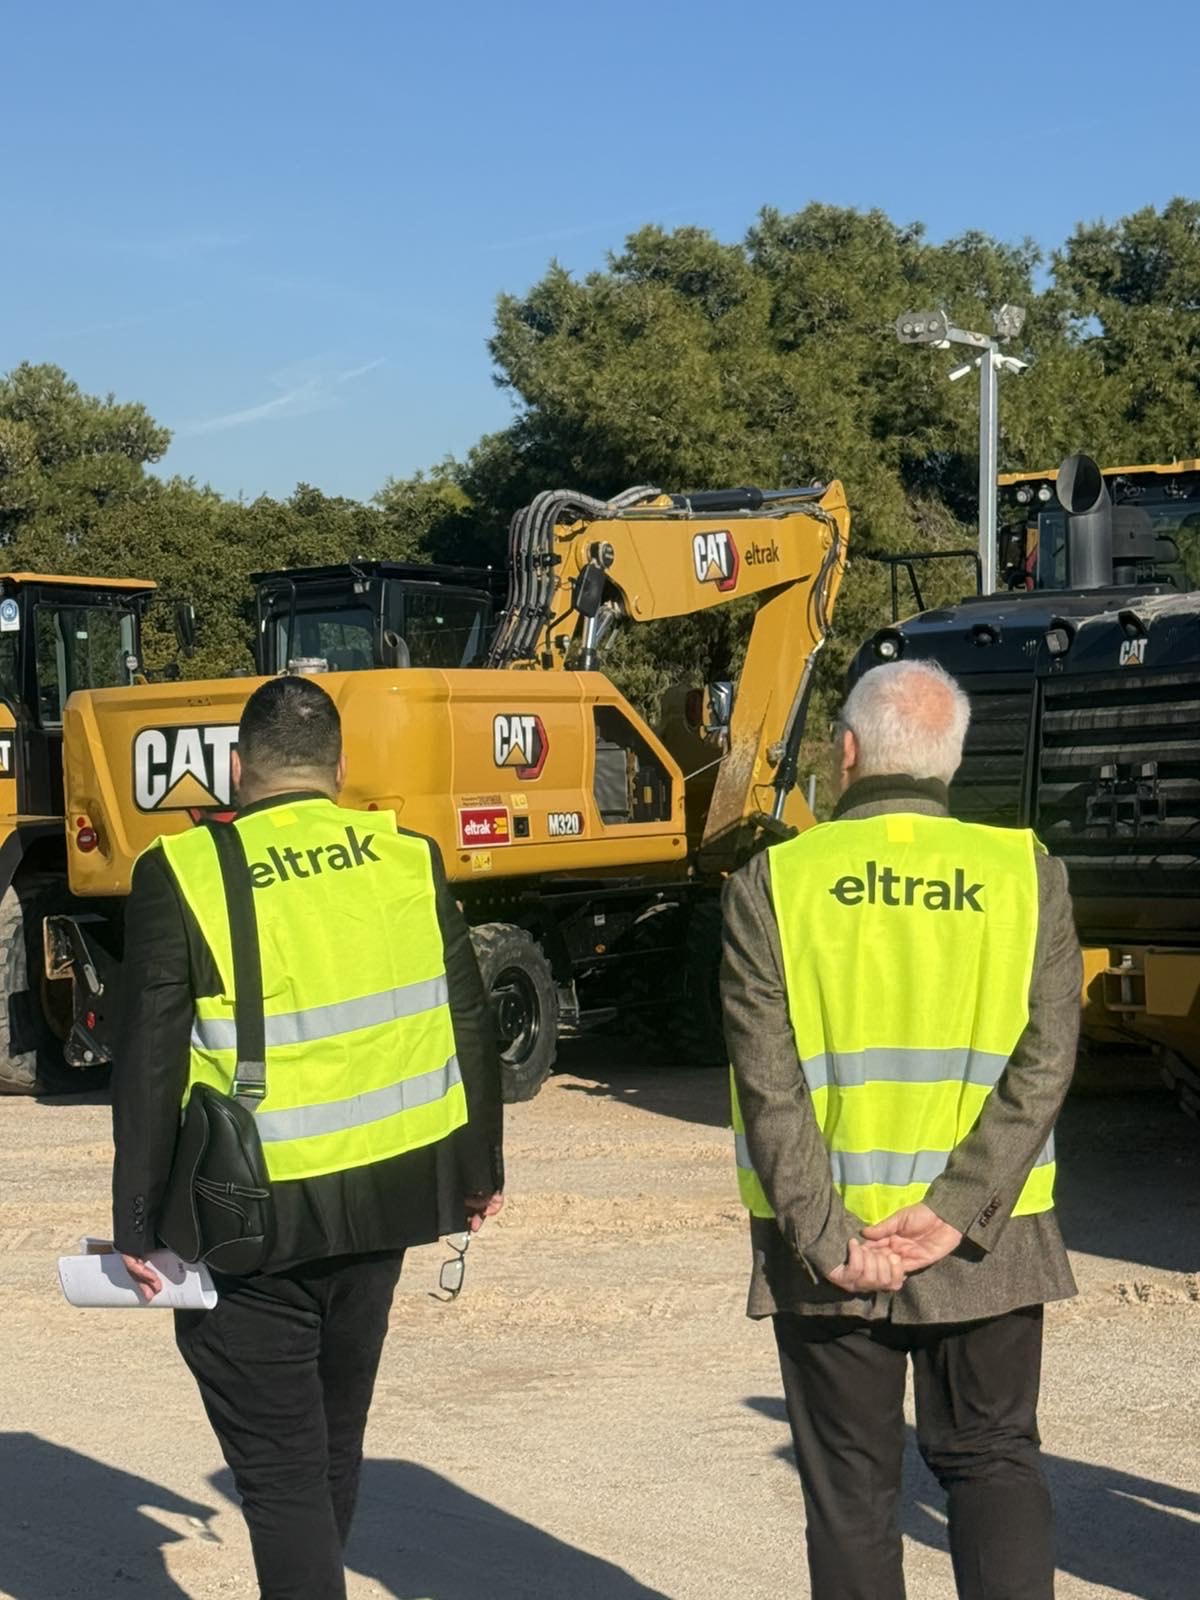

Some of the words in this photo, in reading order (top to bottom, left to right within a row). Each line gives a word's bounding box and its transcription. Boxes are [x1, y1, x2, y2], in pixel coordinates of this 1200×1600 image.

[693, 532, 728, 582] CAT
[744, 538, 780, 566] eltrak
[1119, 638, 1148, 666] CAT
[494, 715, 535, 766] CAT
[134, 726, 240, 809] CAT
[464, 818, 491, 836] eltrak
[548, 813, 580, 835] M320
[248, 825, 382, 889] eltrak
[828, 860, 985, 912] eltrak
